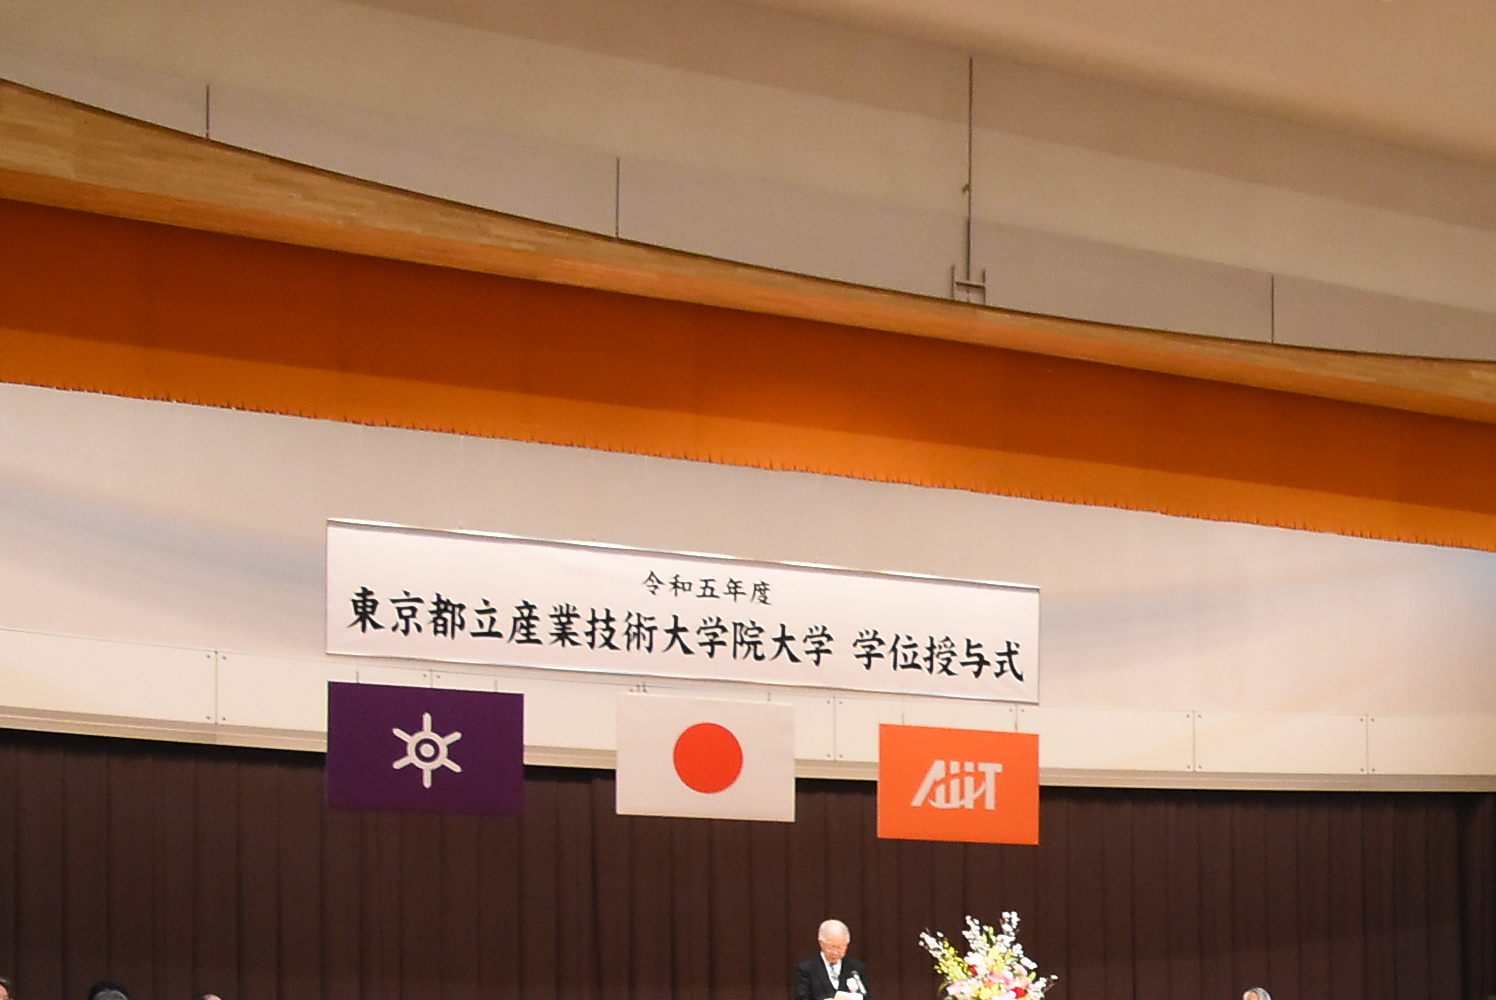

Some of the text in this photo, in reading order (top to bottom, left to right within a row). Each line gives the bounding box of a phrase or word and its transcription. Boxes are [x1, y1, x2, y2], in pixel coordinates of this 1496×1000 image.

[643, 570, 773, 605] 令和五年度
[347, 585, 1025, 682] 東京都立産業技術大学院大学 学位授与式
